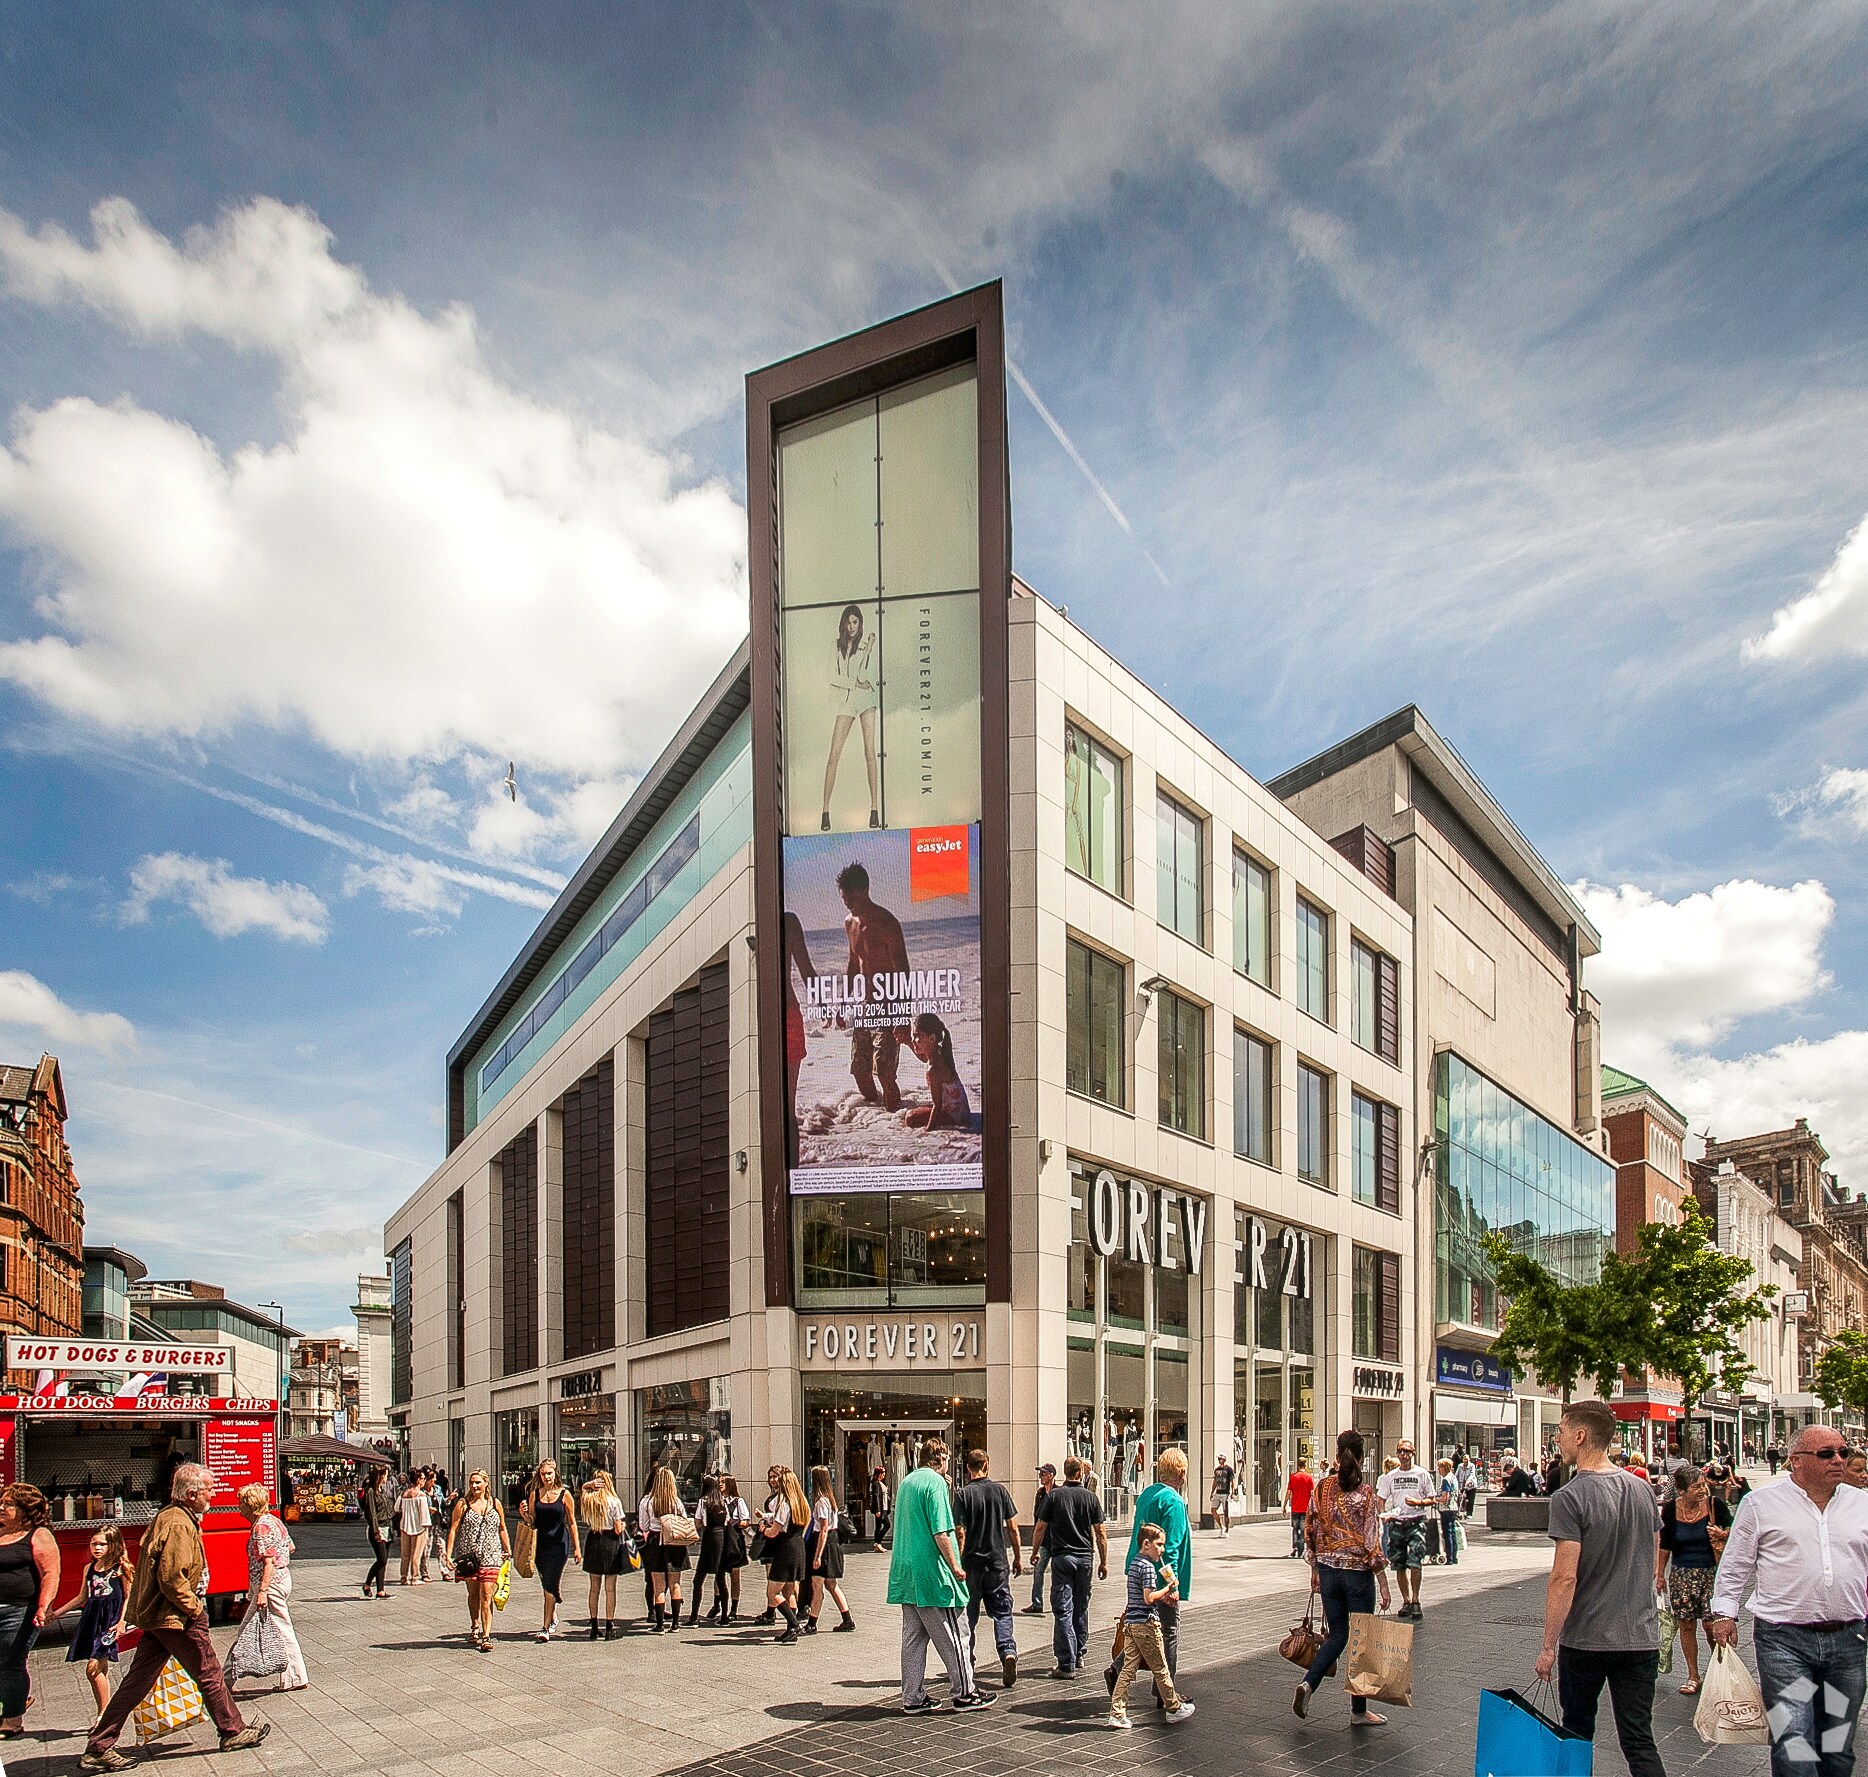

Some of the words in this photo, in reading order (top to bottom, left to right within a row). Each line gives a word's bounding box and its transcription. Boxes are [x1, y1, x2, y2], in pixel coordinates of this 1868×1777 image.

[920, 608, 932, 795] FOREVER21.COM/UK
[916, 836, 944, 845] generation
[916, 840, 962, 854] easyJet
[806, 973, 866, 1004] HELLO
[872, 968, 962, 1001] SUMMER
[807, 1004, 837, 1020] PRICES
[837, 1004, 852, 1018] UP
[853, 1003, 864, 1018] TO
[865, 1002, 885, 1016] 20%
[887, 1001, 917, 1015] LOWER
[919, 1000, 938, 1014] THIS
[940, 999, 961, 1013] YEAR
[854, 1018, 863, 1028] ON
[864, 1017, 892, 1028] SELECTED
[908, 1230, 925, 1245] FOR
[1066, 1161, 1268, 1290] FOREVER
[1278, 1225, 1311, 1299] 21
[903, 1245, 926, 1260] EVER
[806, 1323, 938, 1360] FOREVER
[952, 1323, 979, 1358] 21
[17, 1344, 60, 1362] HOT
[66, 1346, 120, 1363] DOGS
[125, 1349, 138, 1363] &
[142, 1350, 227, 1366] BURGERS
[1354, 1367, 1393, 1391] FOREVER
[1394, 1372, 1404, 1392] 21
[16, 1396, 58, 1410] HOT
[64, 1396, 115, 1410] DOGS
[135, 1396, 210, 1410] BURGERS
[225, 1399, 272, 1411] CHIPS
[1302, 1444, 1308, 1454] B
